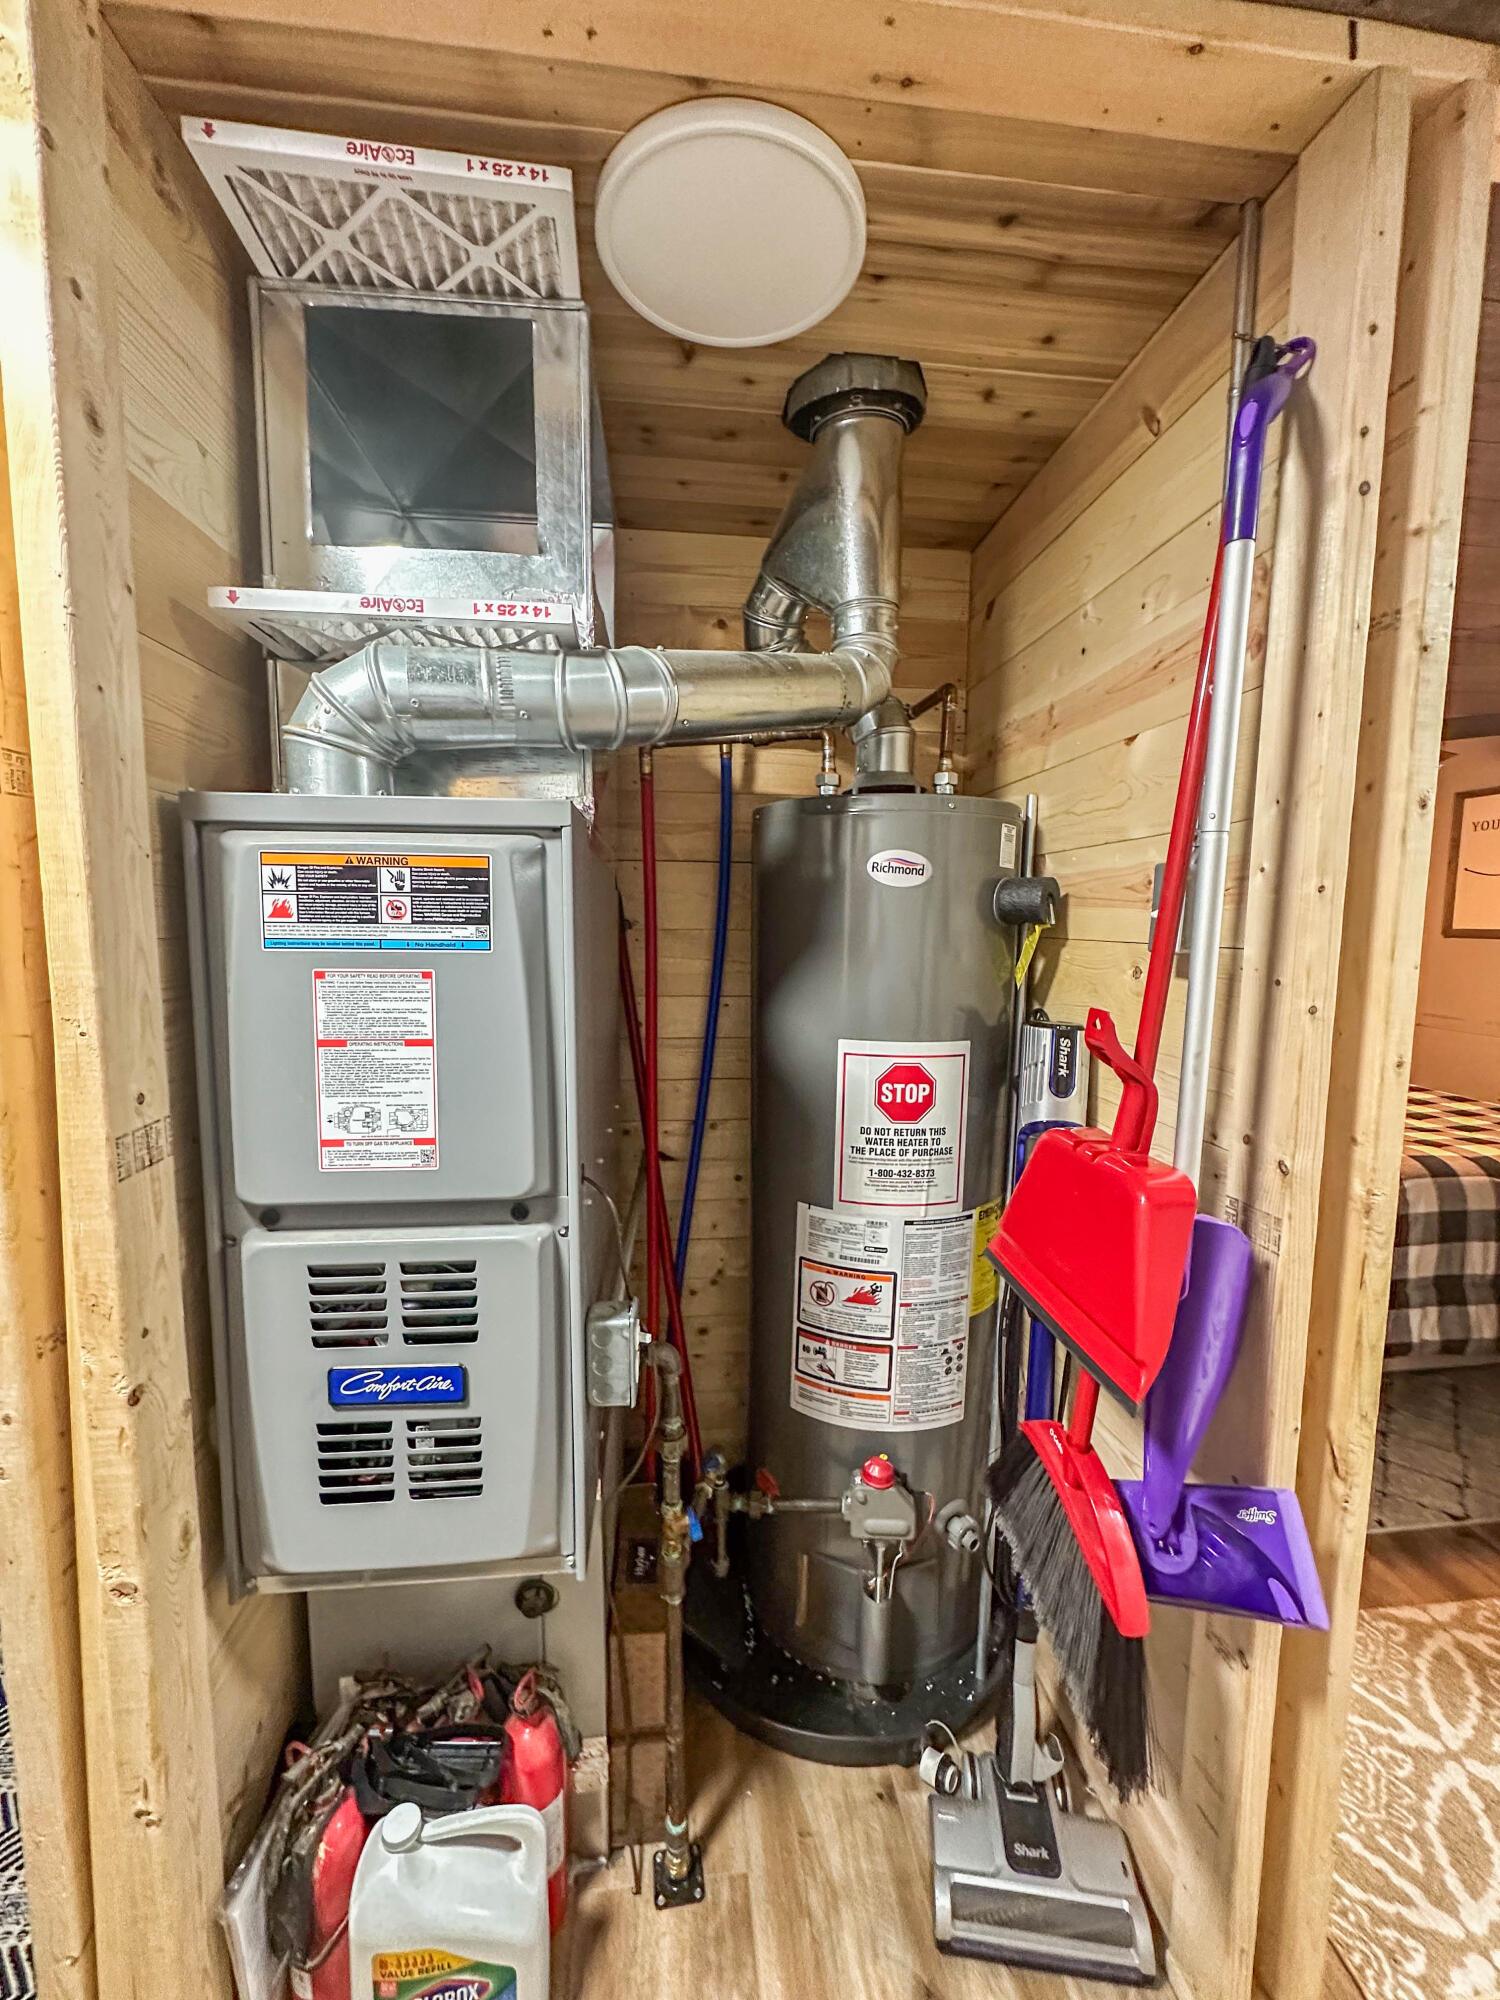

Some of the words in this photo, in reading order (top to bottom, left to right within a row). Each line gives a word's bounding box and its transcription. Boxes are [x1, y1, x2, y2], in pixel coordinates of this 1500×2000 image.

[466, 158, 474, 172] 1
[479, 160, 488, 172] x
[491, 162, 513, 177] 25
[517, 165, 526, 176] x
[528, 166, 549, 181] 14
[473, 602, 480, 614] 1
[484, 603, 493, 613] x
[497, 604, 517, 617] 25
[520, 604, 529, 614] x
[532, 605, 551, 618] 14
[356, 856, 409, 866] WARNING
[871, 861, 925, 876] Richmond
[1058, 1037, 1071, 1078] Shark
[880, 1082, 930, 1103] STOP
[860, 1127, 871, 1136] DO
[874, 1128, 892, 1136] NOT
[894, 1128, 927, 1137] RETURN
[930, 1127, 946, 1136] THIS
[865, 1137, 894, 1146] WATER
[898, 1138, 928, 1147] HEATER
[931, 1138, 941, 1146] TO
[851, 1146, 866, 1156] THE
[869, 1148, 896, 1156] PLACE
[899, 1148, 910, 1156] OF
[912, 1146, 953, 1156] PURCHASE
[868, 1169, 935, 1178] 1-800-432-8373
[834, 1270, 866, 1280] WARNING
[340, 1371, 453, 1400] Comfort-Aire
[1237, 1506, 1277, 1524] Swiffer
[1014, 1842, 1050, 1860] Shark
[380, 1968, 414, 1979] VALUE
[418, 1962, 452, 1976] REFILL
